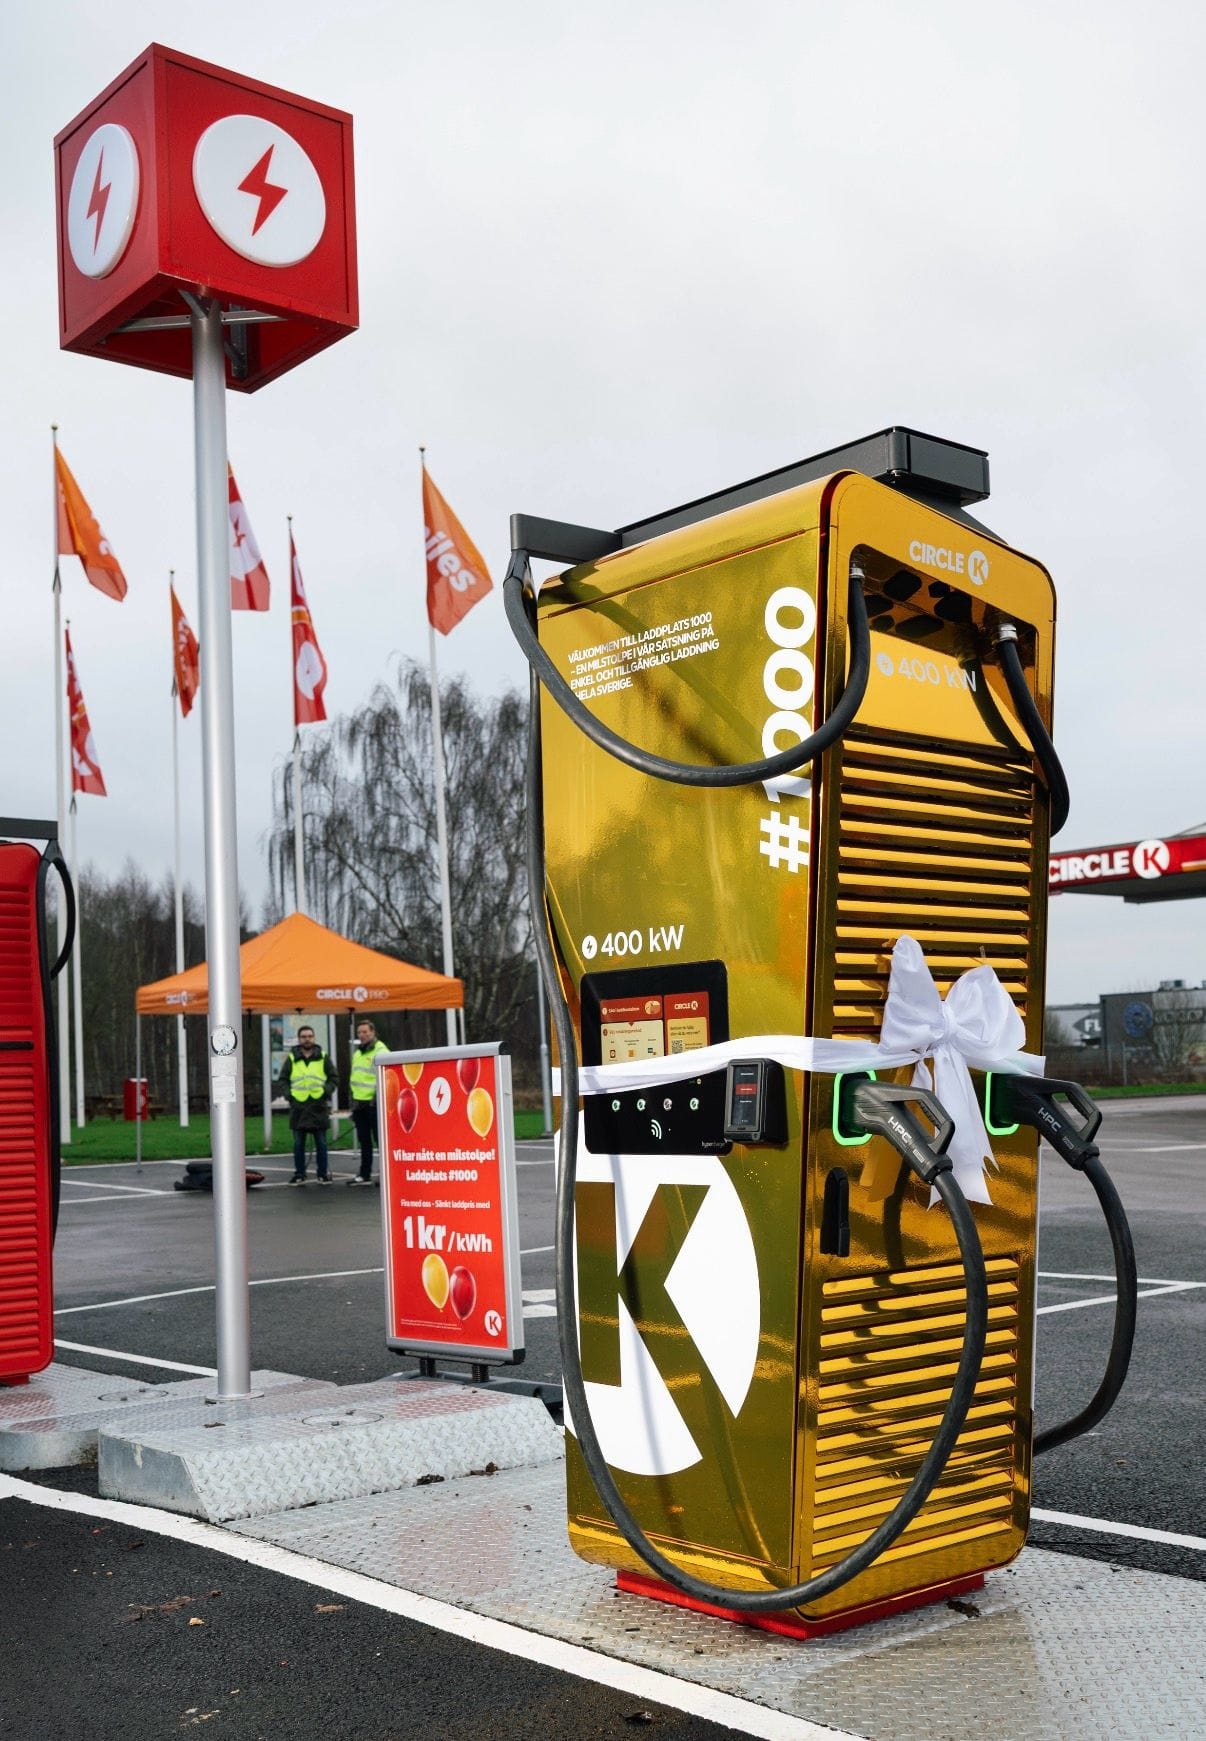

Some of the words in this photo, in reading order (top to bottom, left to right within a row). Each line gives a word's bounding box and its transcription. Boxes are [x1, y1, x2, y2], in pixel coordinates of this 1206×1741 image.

[909, 540, 964, 573] CIRCLE
[568, 641, 619, 663] VÄLKOMMEN
[620, 635, 637, 648] TILL
[638, 619, 690, 642] LADDPLATS
[690, 611, 712, 627] 1000
[576, 663, 588, 675] EN
[587, 651, 633, 672] MILSTOLPE
[638, 643, 655, 657] VÅR
[655, 630, 701, 652] SATSNING
[701, 624, 715, 639] PÅ
[570, 674, 595, 690] ENKEL
[596, 668, 614, 682] OCH
[614, 653, 671, 678] TILLGÄNGLIG
[671, 640, 720, 662] LADDNING
[898, 655, 940, 685] 400
[597, 677, 634, 696] SVERIGE.
[1049, 850, 1130, 883] CIRCLE
[1132, 840, 1170, 879] K
[601, 929, 643, 957] 400
[649, 925, 685, 953] kW
[316, 989, 353, 1000] CIRCLE
[888, 1116, 913, 1144] HPC
[1038, 1107, 1062, 1132] HPC
[393, 1149, 402, 1161] Vi
[402, 1150, 415, 1161] har
[415, 1148, 434, 1161] nått
[435, 1151, 446, 1161] en
[447, 1148, 495, 1164] milstolpe!
[406, 1169, 448, 1184] Laddplats
[448, 1169, 478, 1181] #1000
[475, 1201, 490, 1209] med
[404, 1215, 414, 1249] 1
[417, 1215, 446, 1250] kr
